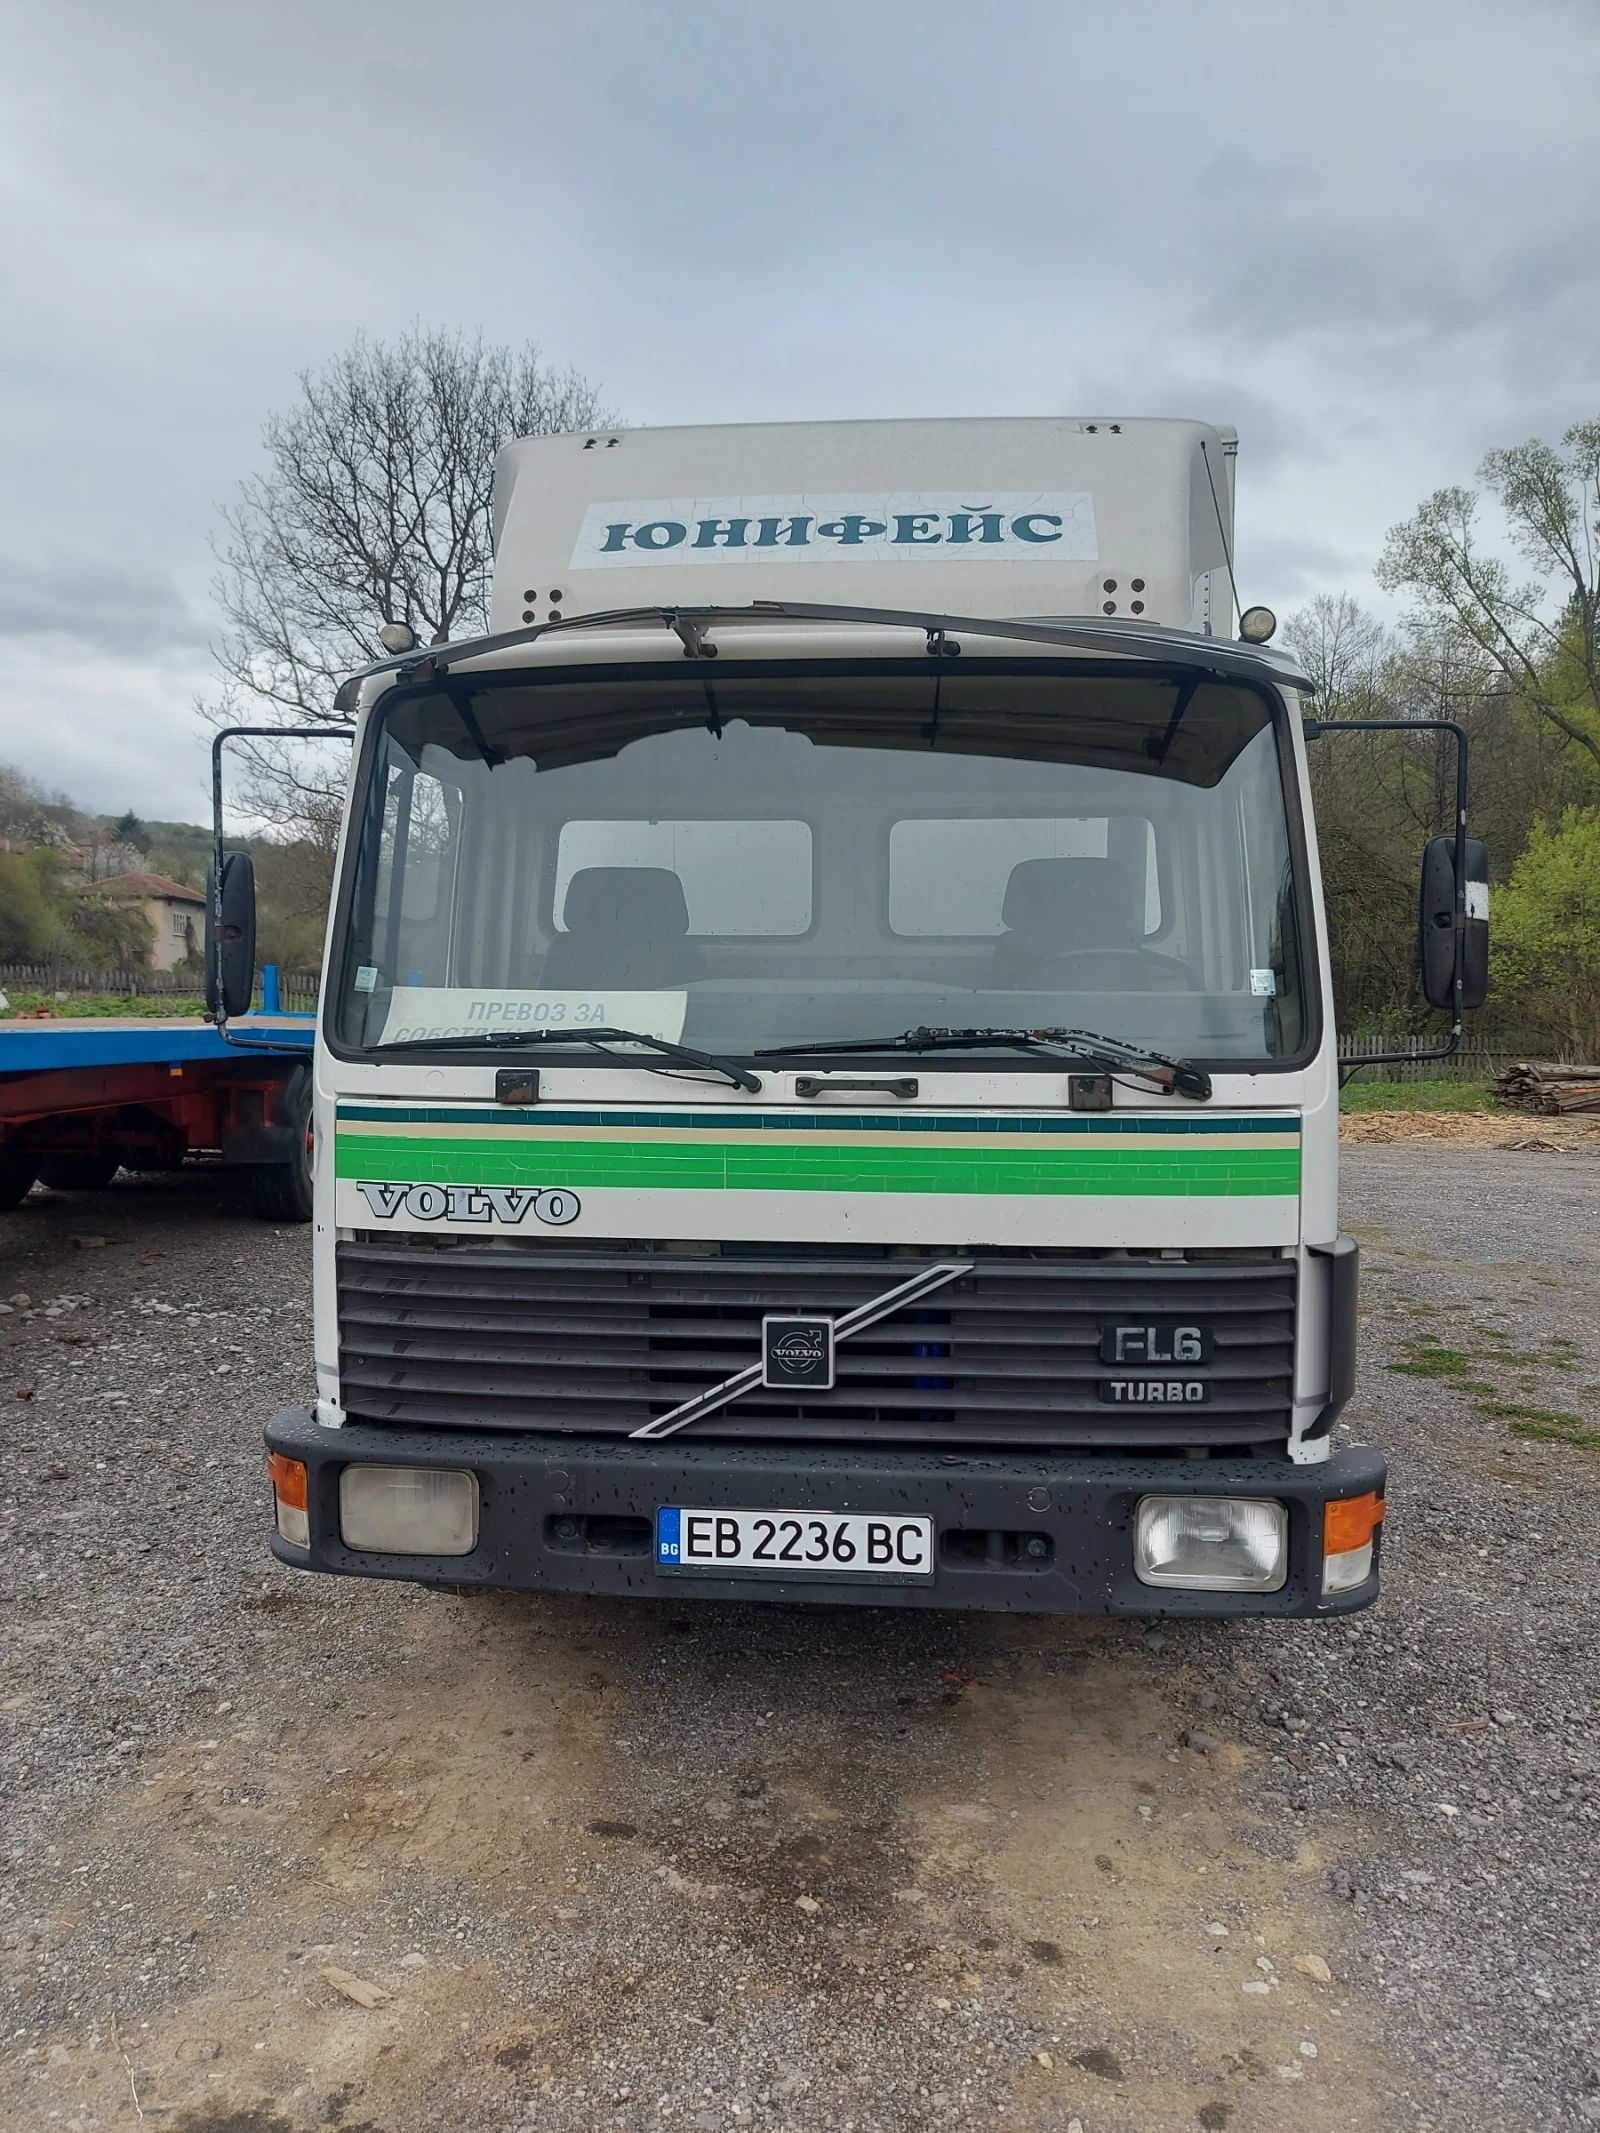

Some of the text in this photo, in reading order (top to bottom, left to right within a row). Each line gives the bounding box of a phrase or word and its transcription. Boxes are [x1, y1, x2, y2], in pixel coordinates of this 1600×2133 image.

[600, 504, 1063, 553] ЮНИФЕЙС
[467, 1001, 606, 1023] ПРЕВОЗ ЗА
[356, 1181, 581, 1225] VOLVO
[774, 1348, 822, 1358] VOLVO
[1115, 1327, 1202, 1361] FL6
[1110, 1382, 1204, 1401] TURBO
[661, 1543, 679, 1556] BG
[687, 1516, 923, 1566] EB 2236 BC
